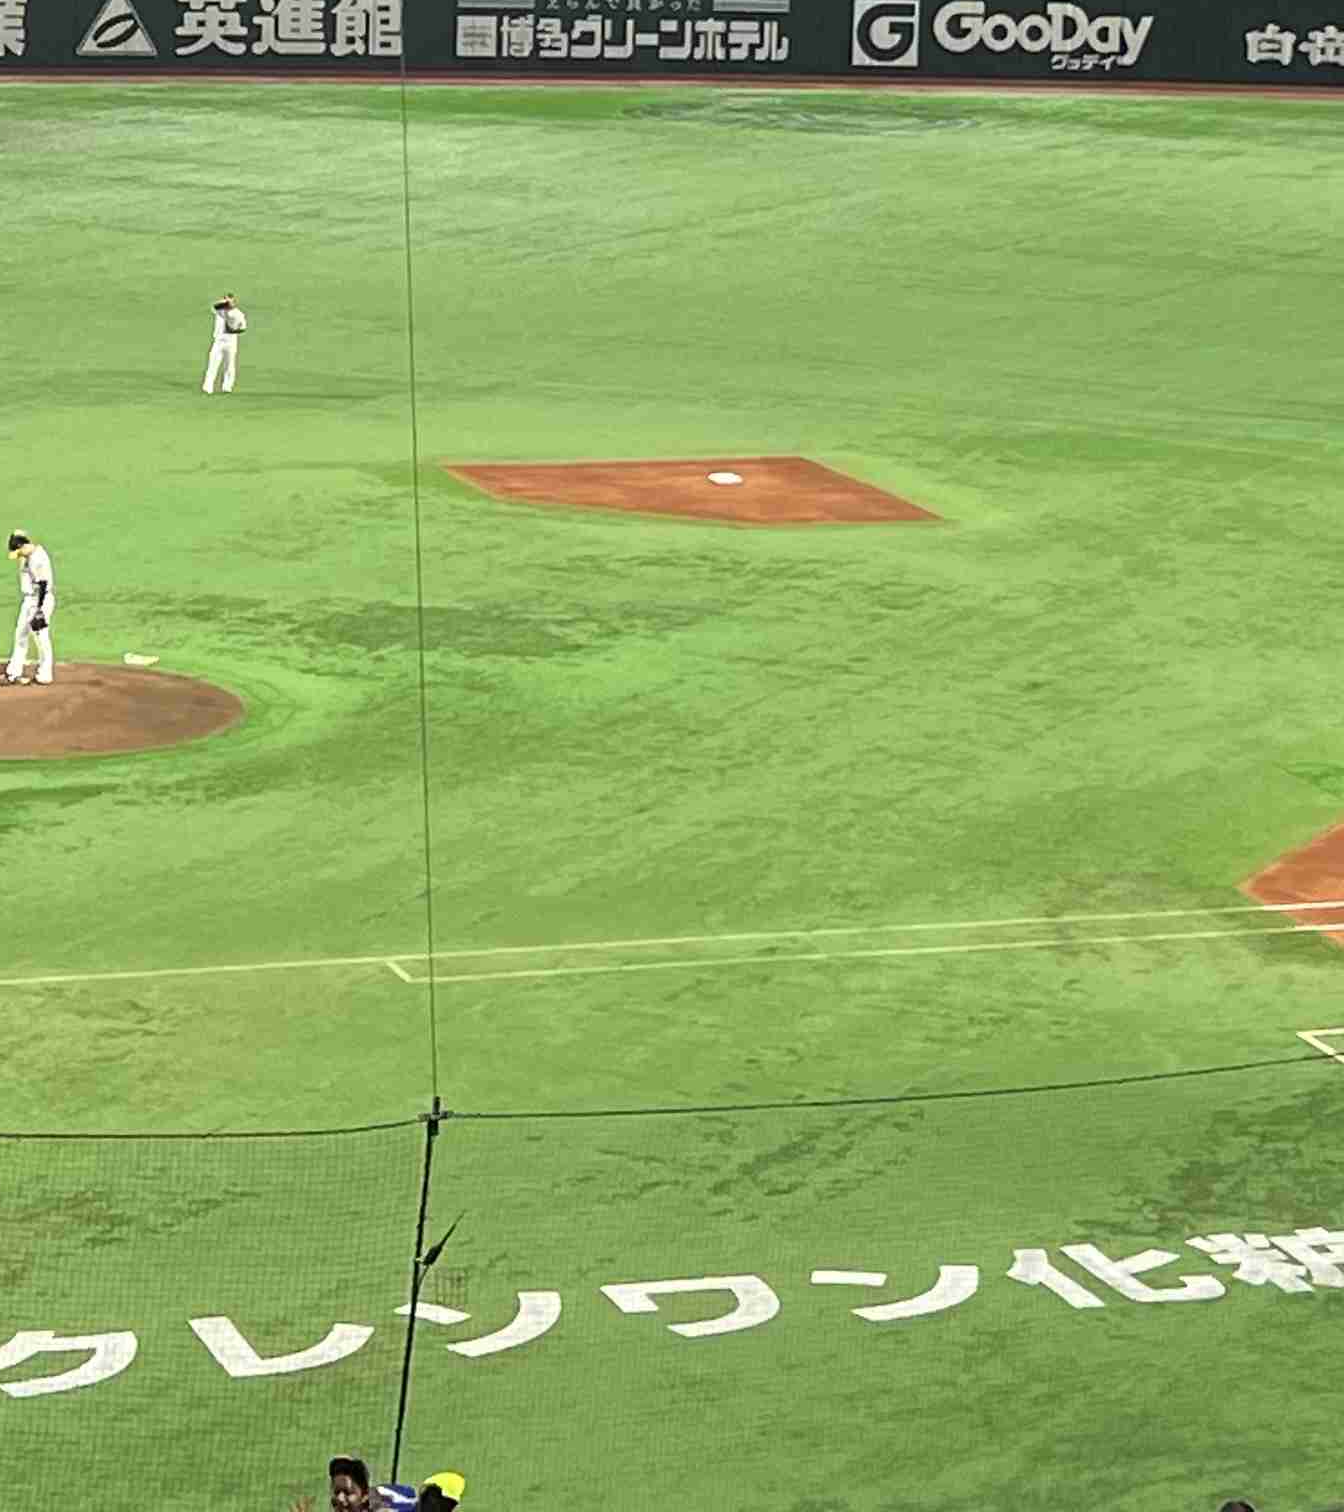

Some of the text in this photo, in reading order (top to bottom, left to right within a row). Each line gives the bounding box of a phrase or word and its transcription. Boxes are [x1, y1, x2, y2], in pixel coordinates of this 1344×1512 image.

[500, 13, 790, 62] 博多グリーンホテル
[932, 0, 1154, 67] GooDay
